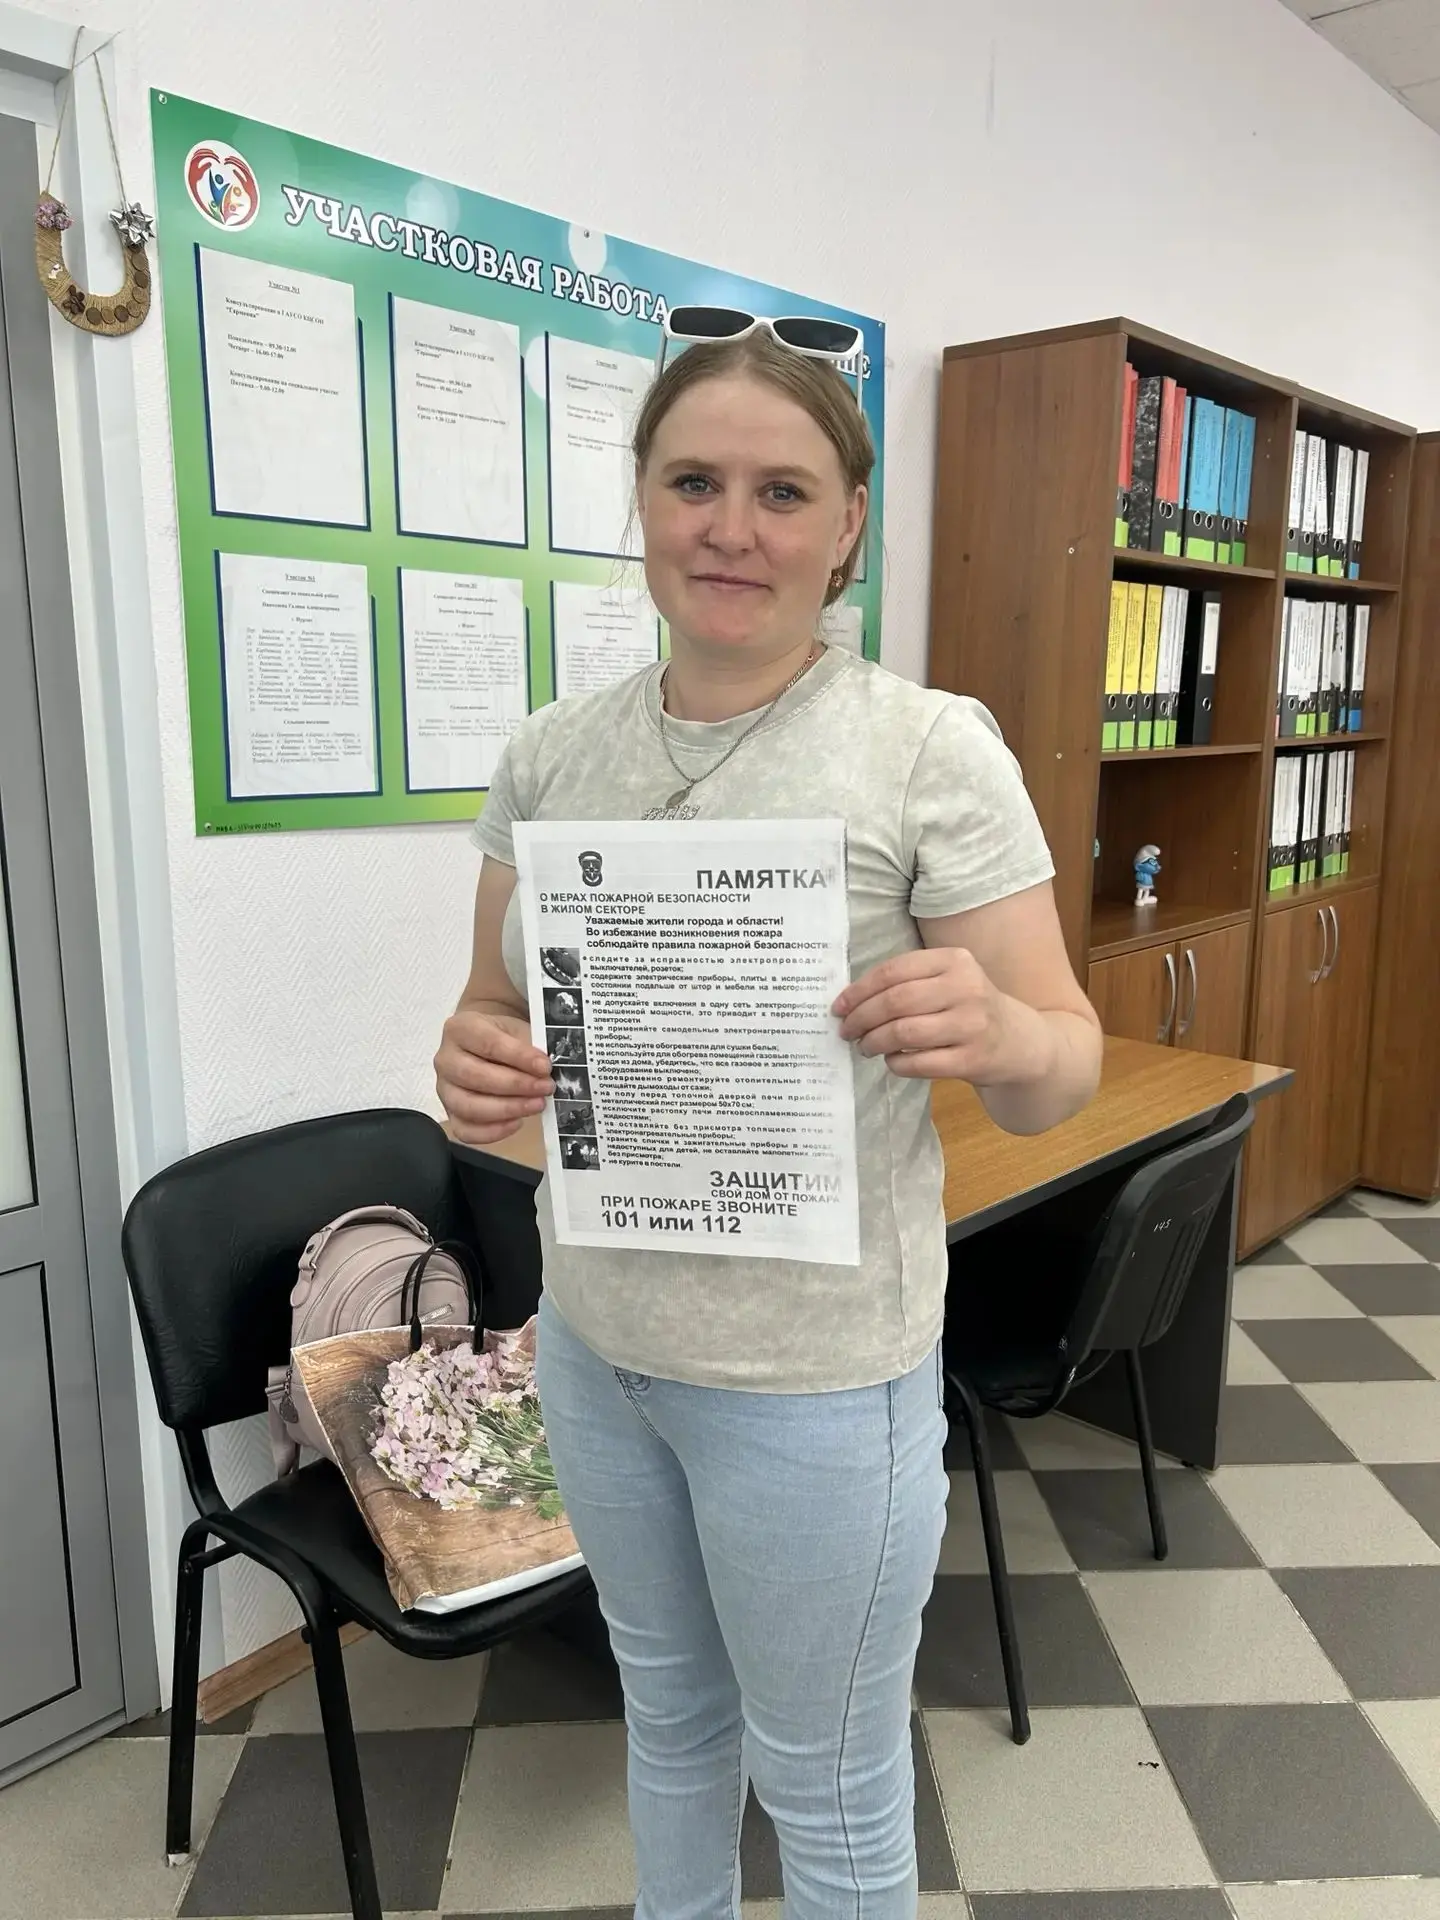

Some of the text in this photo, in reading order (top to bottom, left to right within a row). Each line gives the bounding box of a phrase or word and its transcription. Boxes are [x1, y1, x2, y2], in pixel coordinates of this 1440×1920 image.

[281, 184, 670, 325] УЧАСТКОВАЯ РАБОТА
[695, 869, 827, 889] ПАМЯТКА
[539, 891, 750, 902] О МЕРАХ ПОЖАРНОЙ БЕЗОПАСНОСТИ
[540, 904, 645, 914] В ЖИЛОМ СЕКТОРЕ
[584, 915, 783, 928] Уважаемые жители города области!
[585, 926, 782, 939] Во избежание возникновения пожара
[586, 938, 648, 950] соблюдайте
[650, 940, 695, 951] правила
[697, 939, 751, 952] пожарной
[589, 955, 629, 963] следите
[650, 956, 724, 965] исправностью
[697, 974, 736, 982] приборы,
[635, 982, 675, 990] подальше
[724, 982, 754, 990] мебели
[604, 998, 649, 1007] допускайте
[592, 1006, 645, 1015] повышенной
[716, 1010, 756, 1018] приводит
[607, 1024, 657, 1034] применяйте
[605, 1041, 654, 1050] используйте
[655, 1042, 709, 1051] обогреватели
[606, 1050, 654, 1058] используйте
[709, 1051, 754, 1059] помещений
[597, 1066, 652, 1075] оборудование
[598, 1073, 801, 1085] своевременно ремонтируйте отопительные
[637, 1083, 679, 1091] дымоходы
[601, 1097, 660, 1106] металлический
[679, 1100, 717, 1108] размером
[718, 1092, 756, 1101] дверкой
[650, 1107, 687, 1115] растопку
[618, 1121, 669, 1129] оставляйте
[693, 1124, 741, 1133] присмотра
[747, 1126, 796, 1134] топящиеся
[606, 1135, 637, 1143] храните
[683, 1138, 745, 1148] зажигательные
[750, 1141, 788, 1149] приборы
[606, 1143, 655, 1151] недоступных
[714, 1147, 759, 1155] оставляйте
[708, 1169, 842, 1192] ЗАЩИТИМ
[710, 1187, 840, 1204] СВОЙ ДОМ ОТ ПОЖАРА
[600, 1194, 797, 1216] ПРИ ПОЖАРЕ ЗВОНИТЕ
[601, 1209, 741, 1234] 101 или 112
[1153, 1218, 1172, 1233] 145
